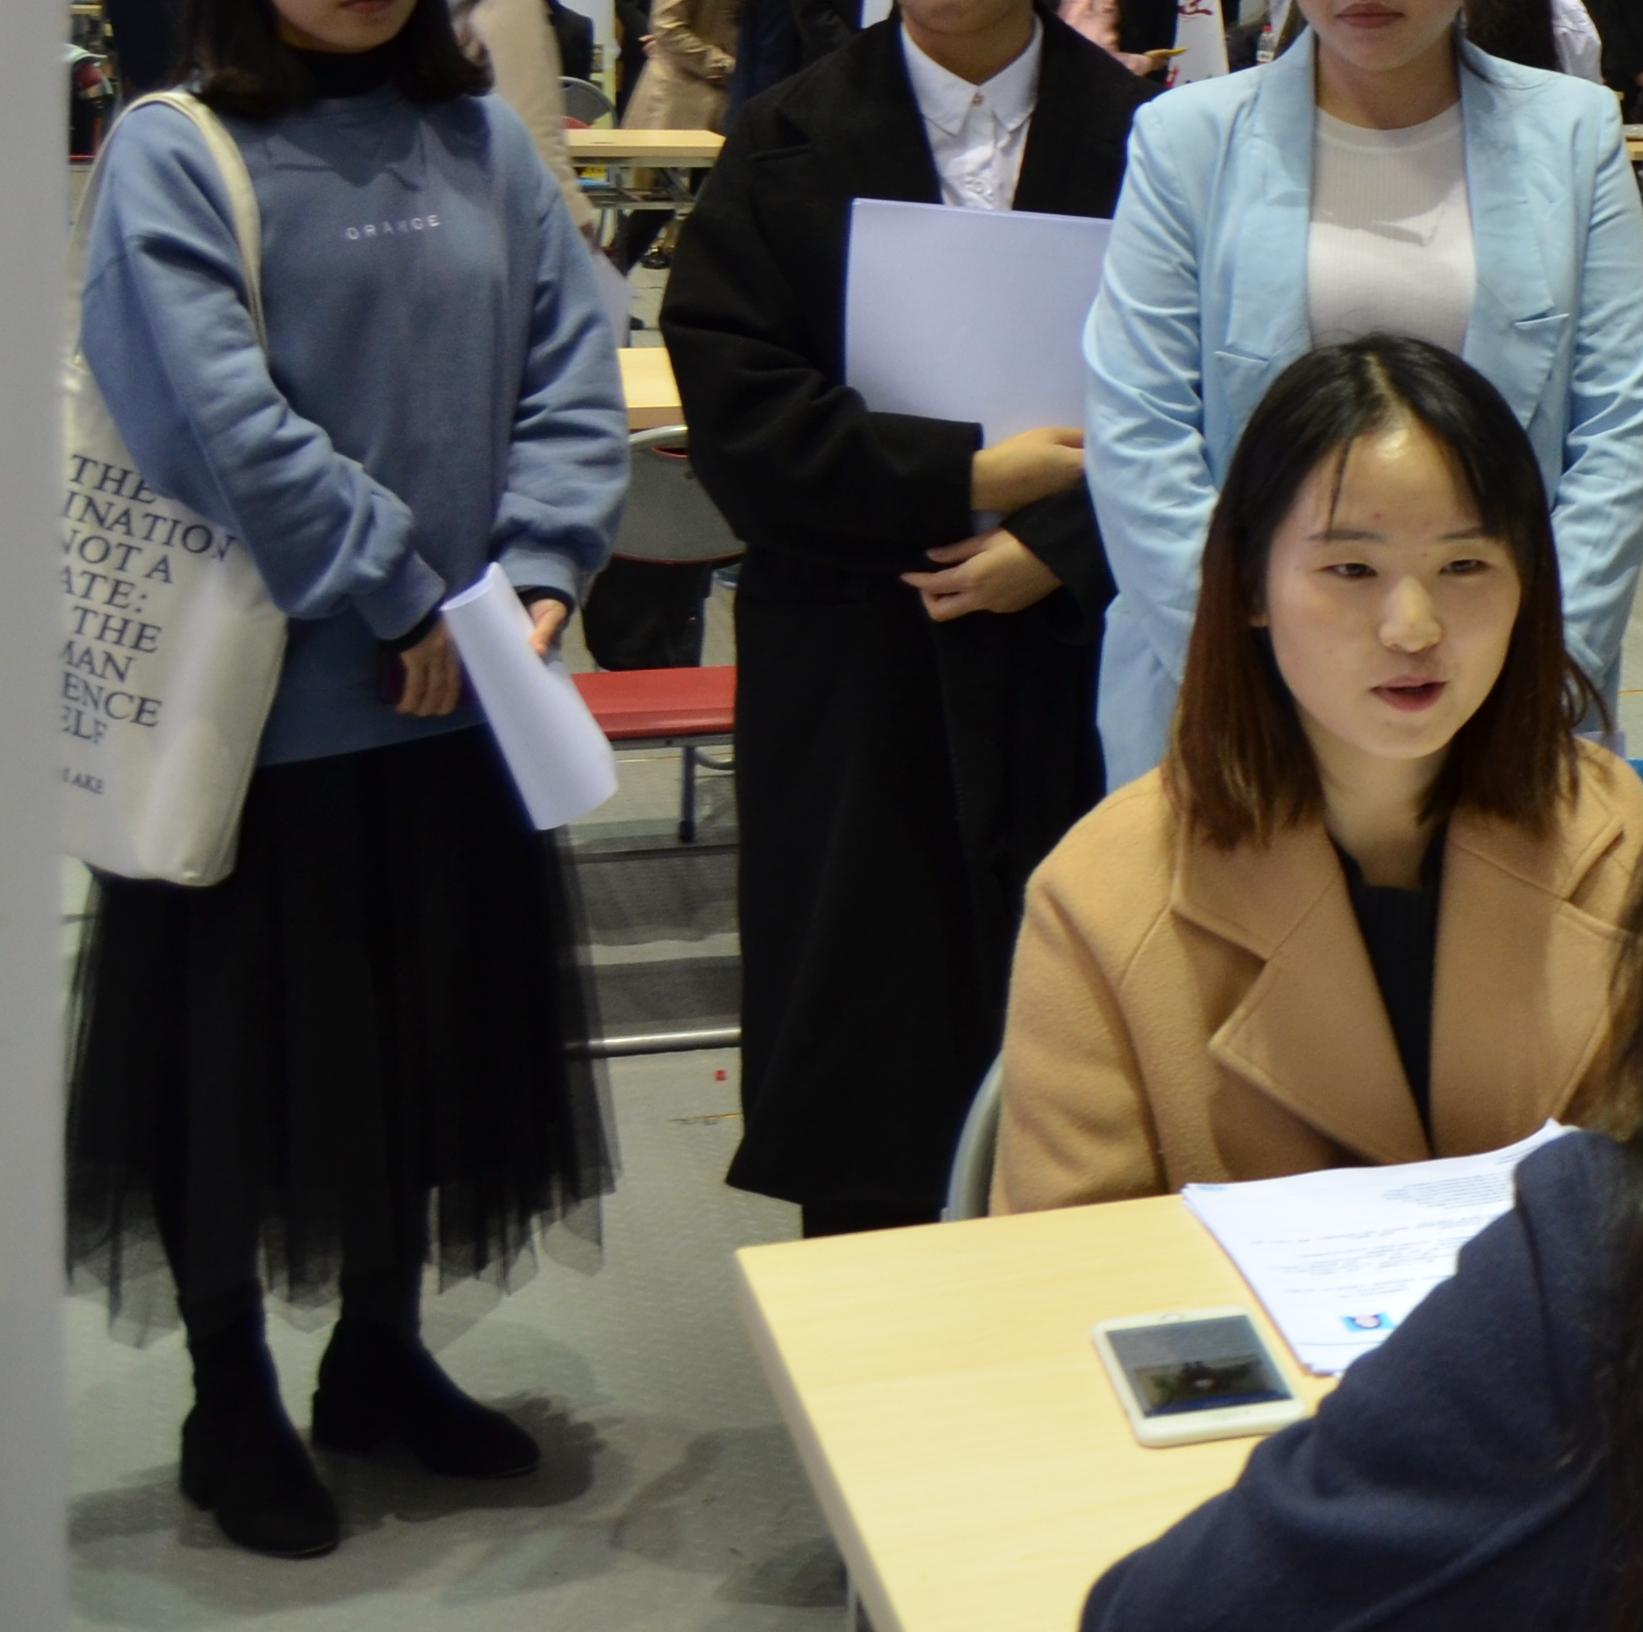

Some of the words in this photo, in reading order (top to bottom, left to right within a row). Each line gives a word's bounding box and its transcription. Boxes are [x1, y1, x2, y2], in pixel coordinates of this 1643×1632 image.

[70, 454, 157, 505] THE
[143, 553, 174, 585] A
[72, 606, 163, 655] THE
[63, 670, 164, 729] ENCE
